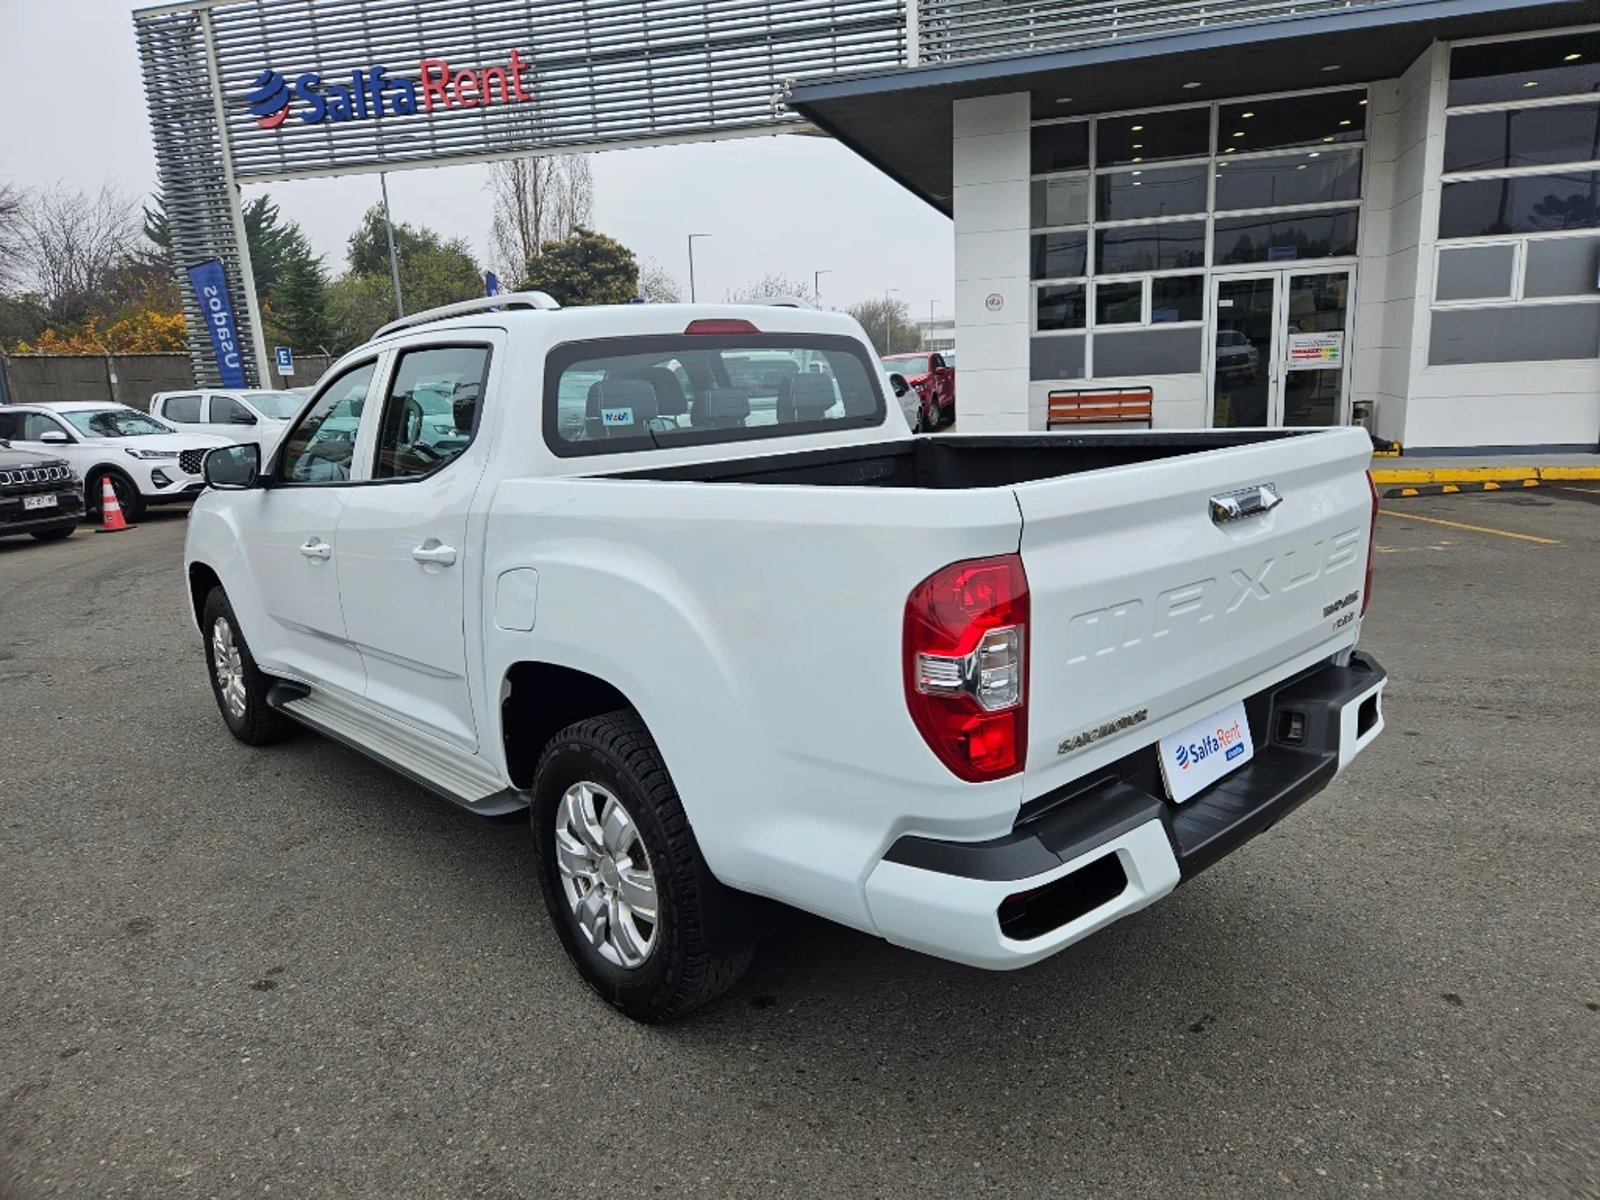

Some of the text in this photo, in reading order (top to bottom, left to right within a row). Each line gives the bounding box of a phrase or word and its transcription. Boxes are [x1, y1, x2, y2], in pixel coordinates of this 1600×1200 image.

[279, 350, 289, 364] E
[1066, 526, 1360, 665] MAXUS
[1189, 719, 1242, 764] SalfaRent
